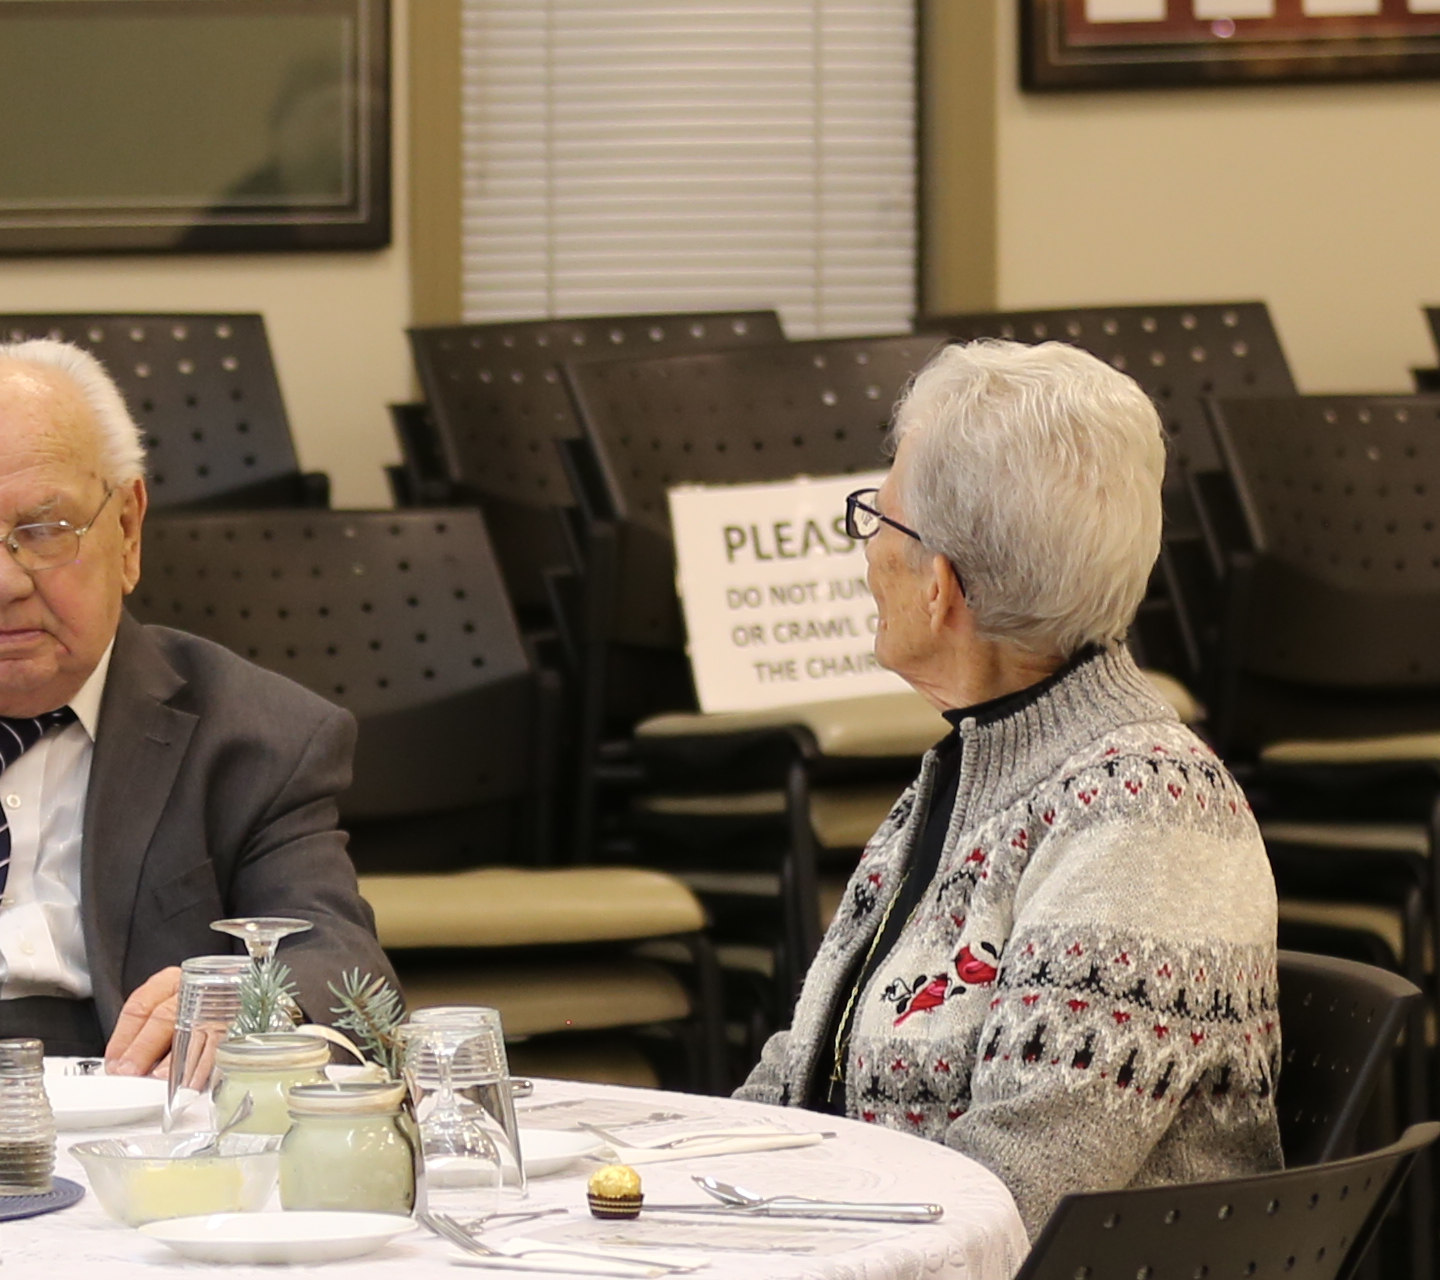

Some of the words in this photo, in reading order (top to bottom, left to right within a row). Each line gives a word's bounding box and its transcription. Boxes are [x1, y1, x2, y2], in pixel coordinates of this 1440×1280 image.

[722, 516, 870, 564] PLEAS
[726, 586, 762, 609] DO
[769, 580, 817, 605] NOT
[732, 622, 766, 647] OR
[773, 616, 860, 644] CRAWL
[753, 657, 798, 683] THE
[806, 651, 878, 678] CHAIR
